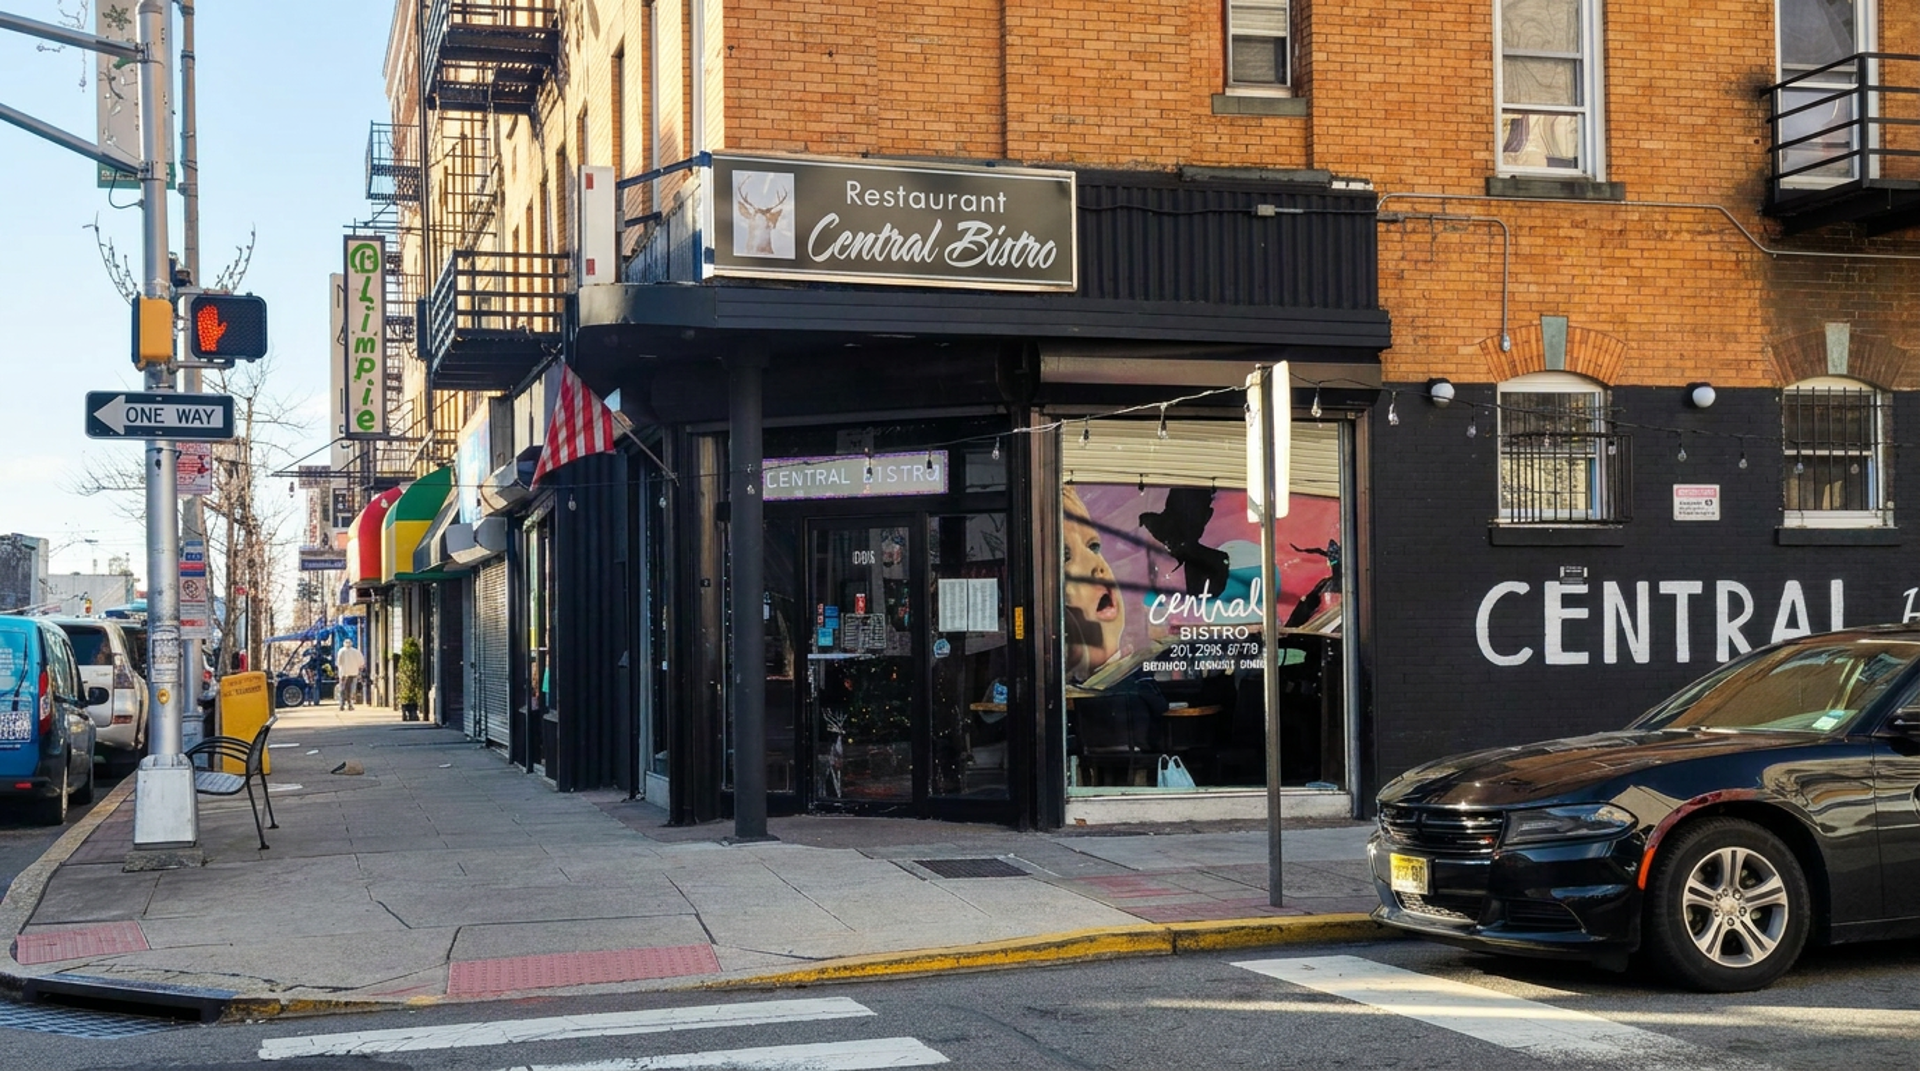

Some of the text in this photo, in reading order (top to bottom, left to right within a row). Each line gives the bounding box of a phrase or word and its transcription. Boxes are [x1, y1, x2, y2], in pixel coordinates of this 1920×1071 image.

[846, 180, 1007, 213] Restaurant
[807, 212, 1057, 269] Central Bistro
[125, 406, 216, 425] ONE WAY
[766, 468, 851, 489] CENTRAL
[1149, 576, 1264, 625] central
[1180, 626, 1249, 640] BISTRO
